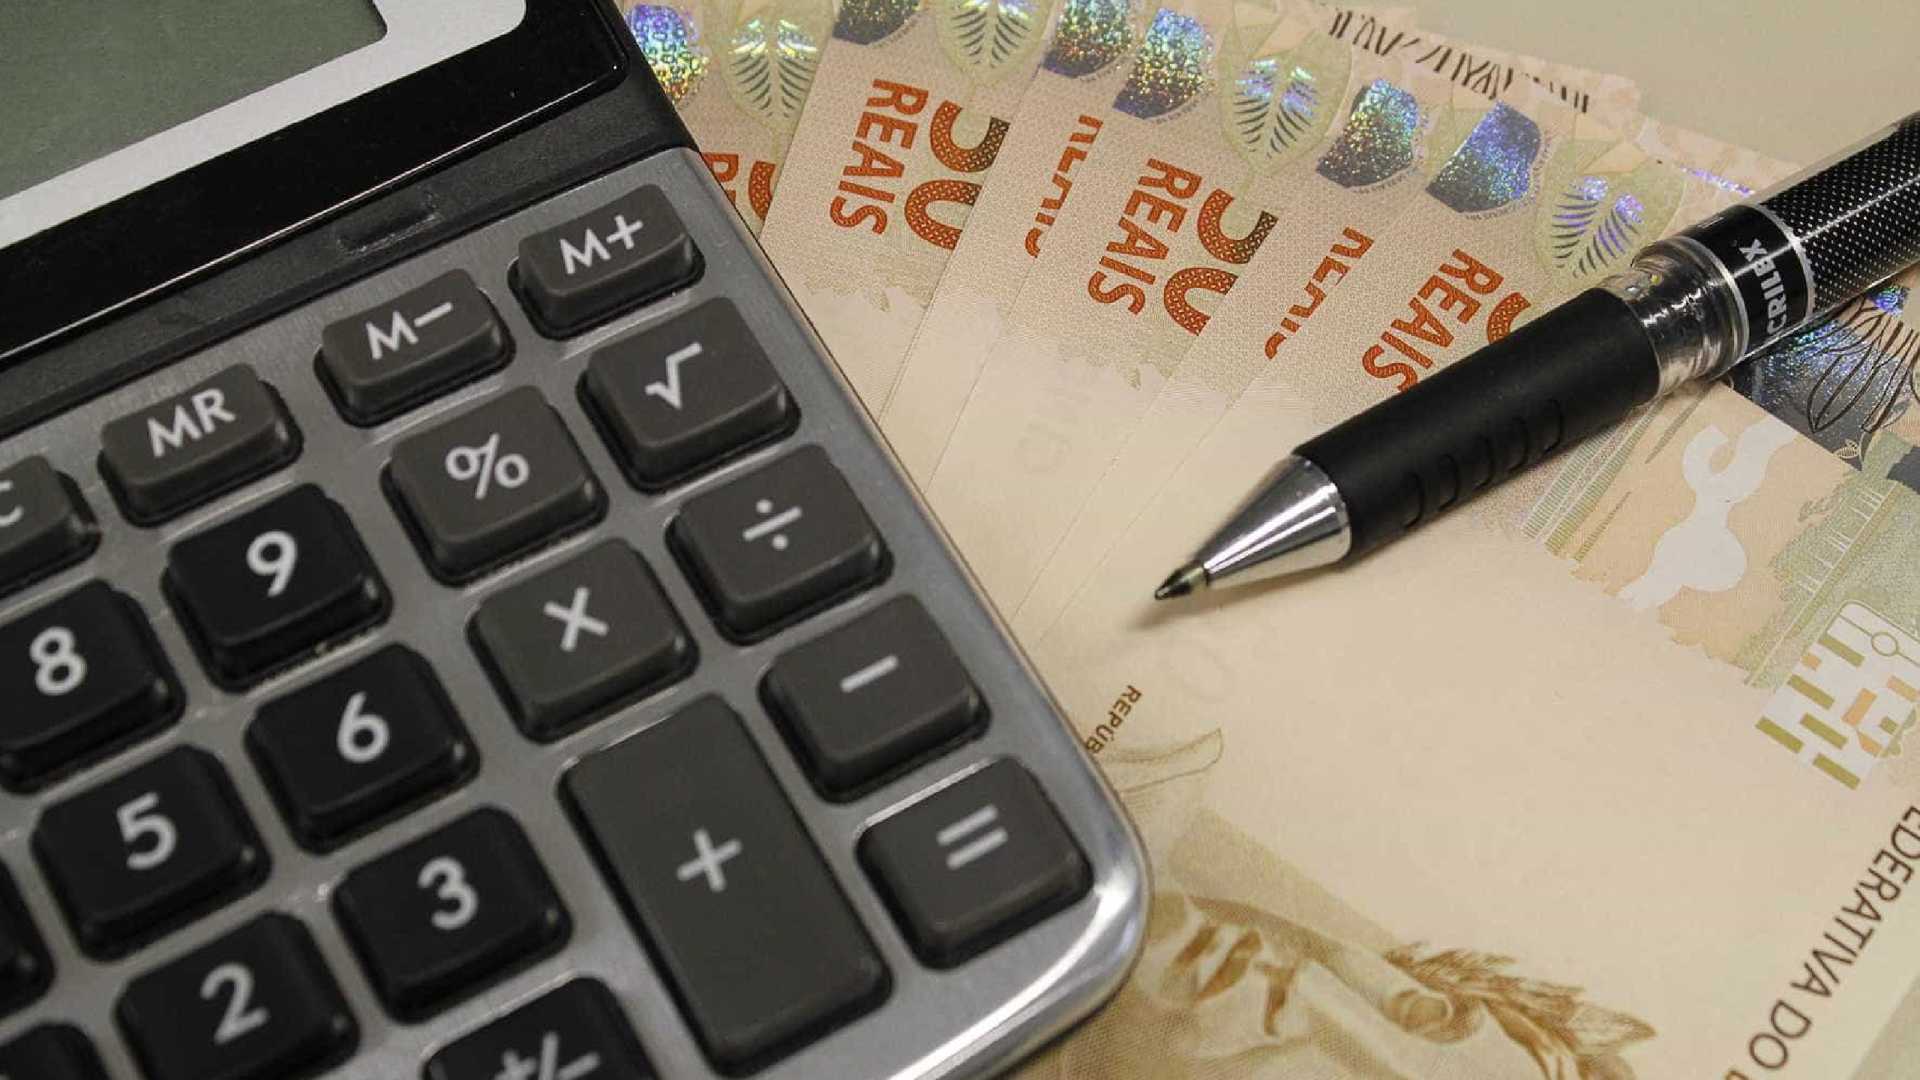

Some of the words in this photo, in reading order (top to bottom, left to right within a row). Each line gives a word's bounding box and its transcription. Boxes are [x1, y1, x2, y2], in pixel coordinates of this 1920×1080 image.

[830, 79, 929, 234] REAIS
[560, 214, 644, 276] M+
[1088, 158, 1202, 316] REAIS
[1362, 248, 1504, 393] REAIS
[147, 386, 236, 458] MR
[445, 433, 530, 500] %
[247, 530, 296, 595] 9
[30, 627, 86, 695] 8
[338, 692, 389, 762] 6
[117, 794, 175, 869] 5
[419, 858, 476, 929] 3
[202, 964, 263, 1039] 2
[1748, 999, 1812, 1070] DO
